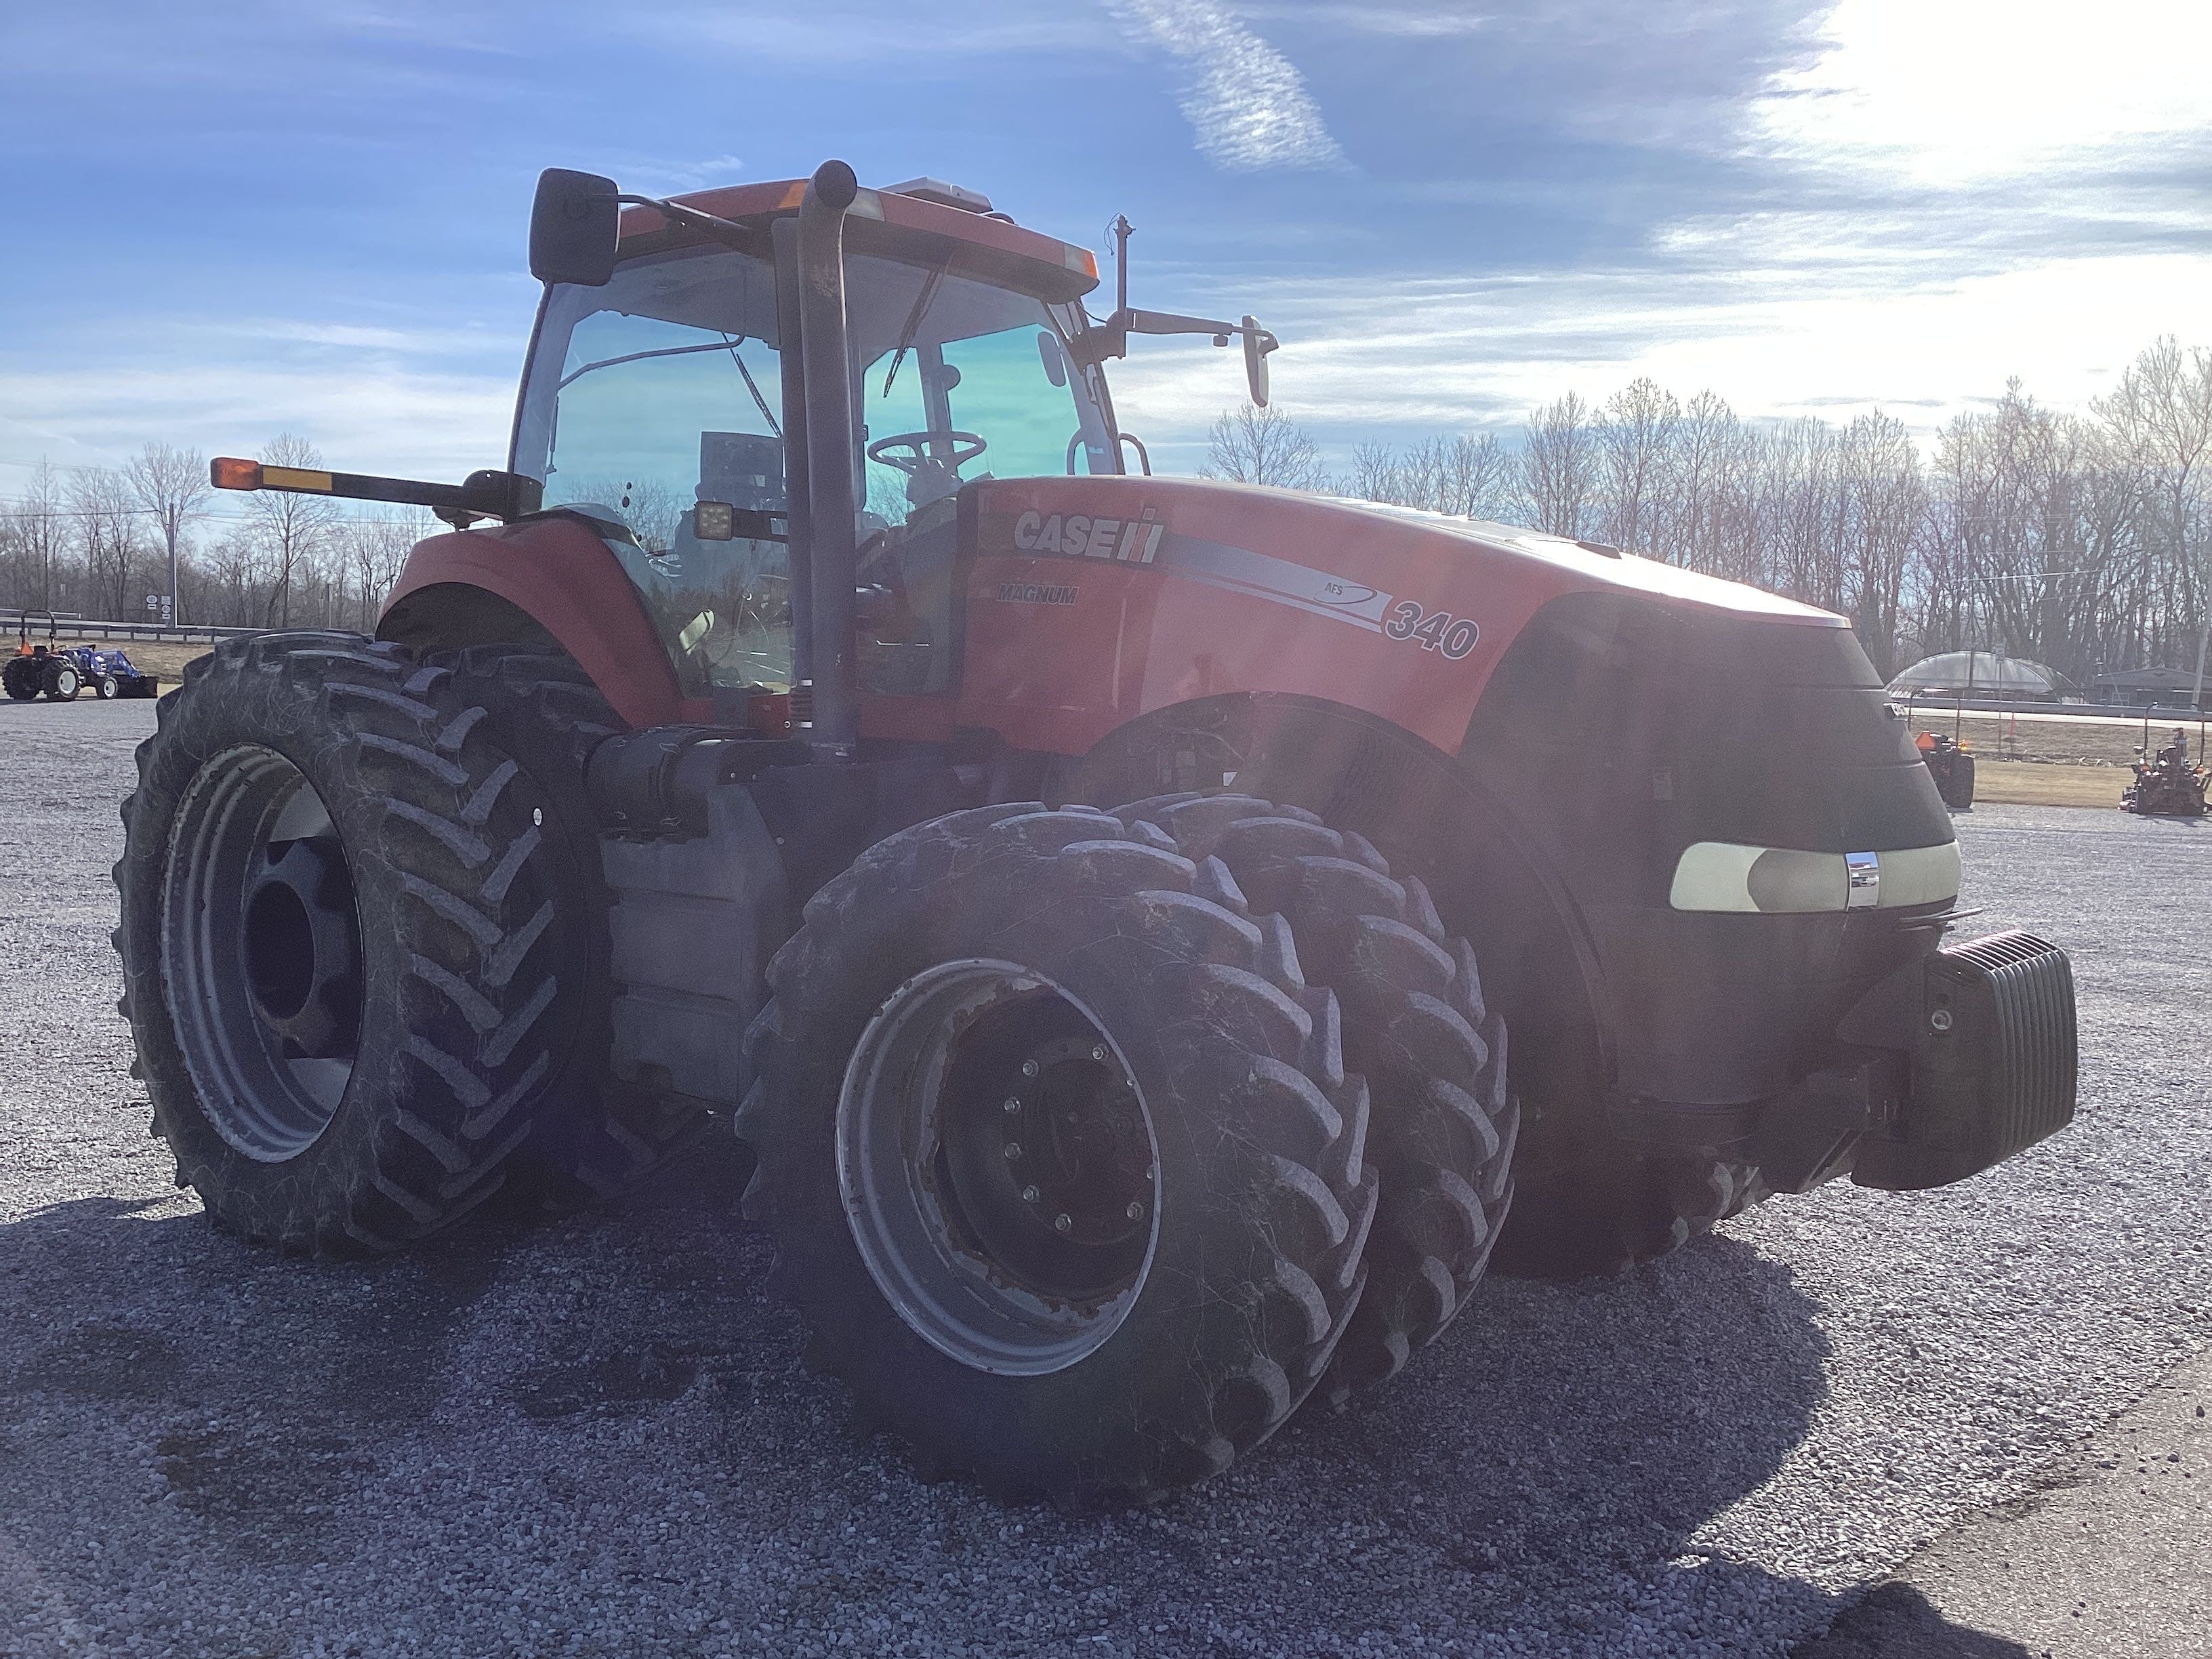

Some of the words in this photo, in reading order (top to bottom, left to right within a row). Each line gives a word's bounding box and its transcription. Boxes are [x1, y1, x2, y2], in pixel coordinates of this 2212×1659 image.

[1015, 511, 1120, 558] CASE
[996, 583, 1080, 605] MAGNUM
[1325, 582, 1343, 596] AFS
[1385, 600, 1480, 659] 340
